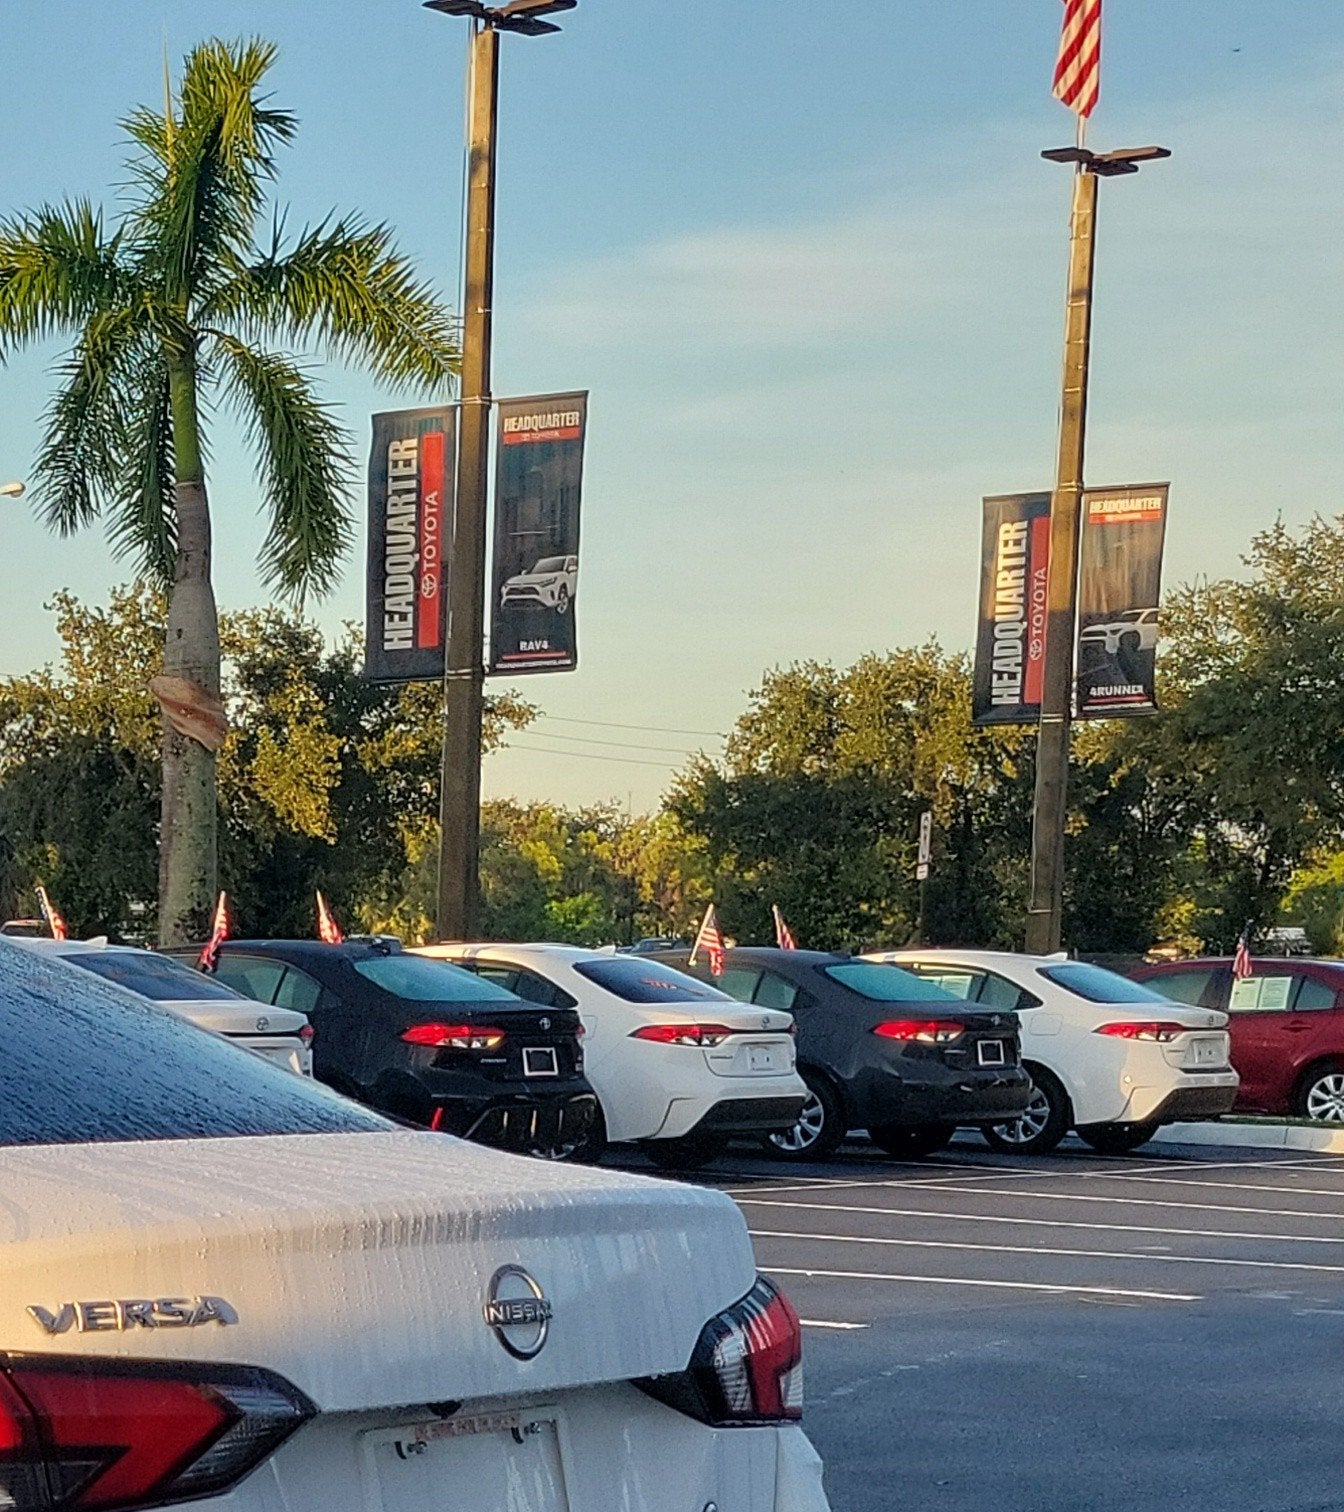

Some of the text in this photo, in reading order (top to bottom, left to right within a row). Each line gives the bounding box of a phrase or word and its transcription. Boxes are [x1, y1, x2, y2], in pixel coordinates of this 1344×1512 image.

[503, 411, 580, 432] HEADQUARTER
[383, 437, 420, 651] HEADQUARTER
[423, 491, 439, 571] TOYOTA
[991, 520, 1028, 705] HEADQUARTER
[1032, 567, 1048, 638] TOYOTA
[519, 640, 548, 651] RAV4
[26, 1296, 239, 1335] VERSA
